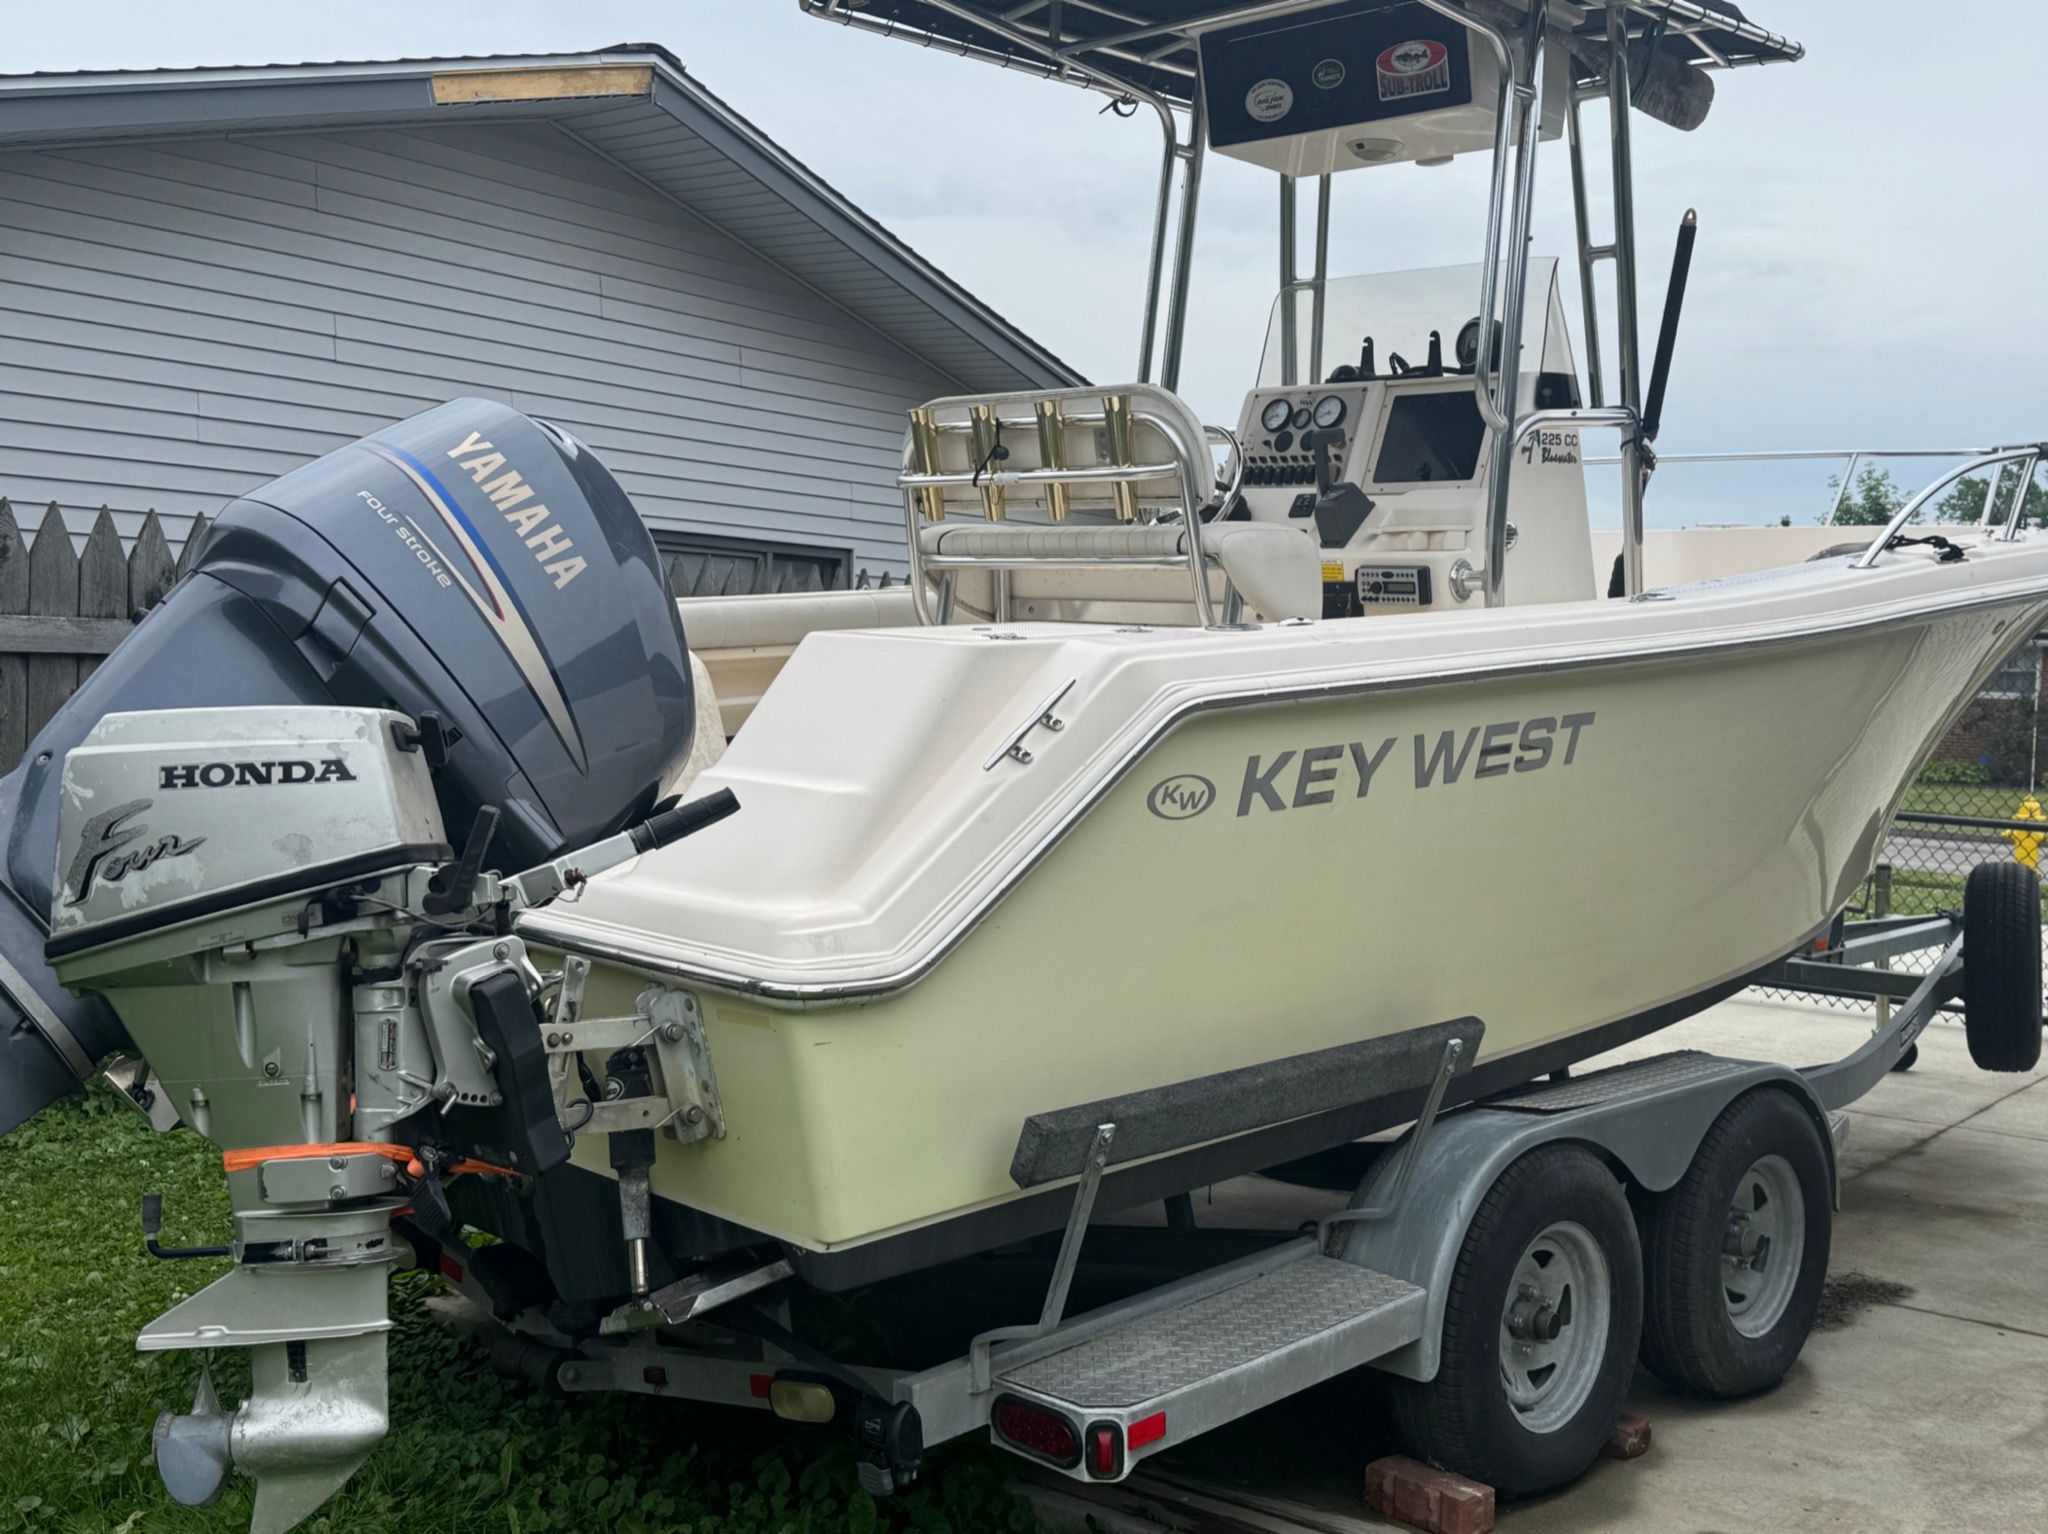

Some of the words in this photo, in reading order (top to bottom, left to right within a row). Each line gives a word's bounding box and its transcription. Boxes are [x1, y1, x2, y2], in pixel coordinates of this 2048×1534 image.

[1541, 432, 1562, 446] 225
[1564, 433, 1578, 447] CC
[447, 431, 588, 590] YAMAHA
[160, 759, 357, 788] HONDA
[1236, 737, 1398, 817] KEY
[1414, 711, 1596, 788] WEST
[1161, 784, 1206, 811] KW
